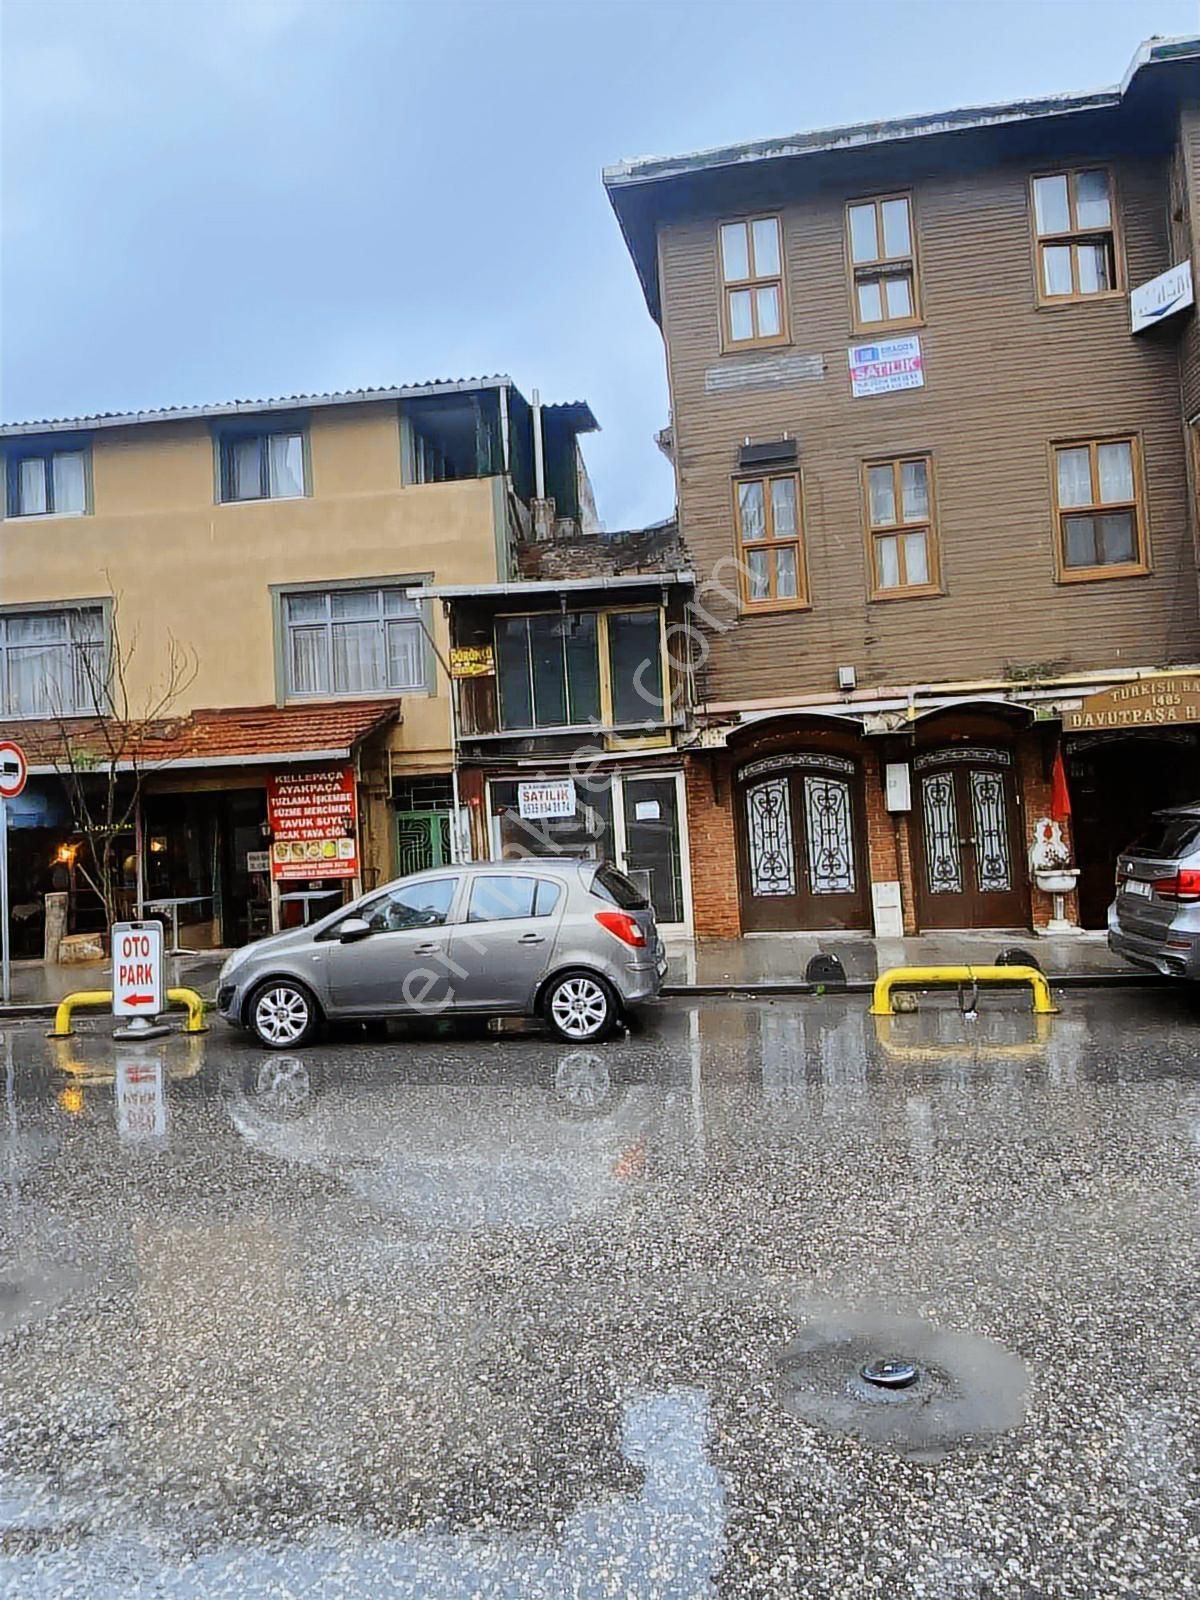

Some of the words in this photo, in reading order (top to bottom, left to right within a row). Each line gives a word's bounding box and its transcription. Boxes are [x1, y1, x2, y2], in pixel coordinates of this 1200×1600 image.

[854, 358, 917, 380] SATILIK
[1110, 681, 1175, 703] TURKISH
[1072, 707, 1178, 728] DAVUTPAŞA
[523, 788, 570, 802] SATILIK
[280, 818, 314, 829] TAVUK
[302, 828, 325, 839] TAVA
[123, 935, 150, 958] OTO
[119, 963, 154, 987] PARK
